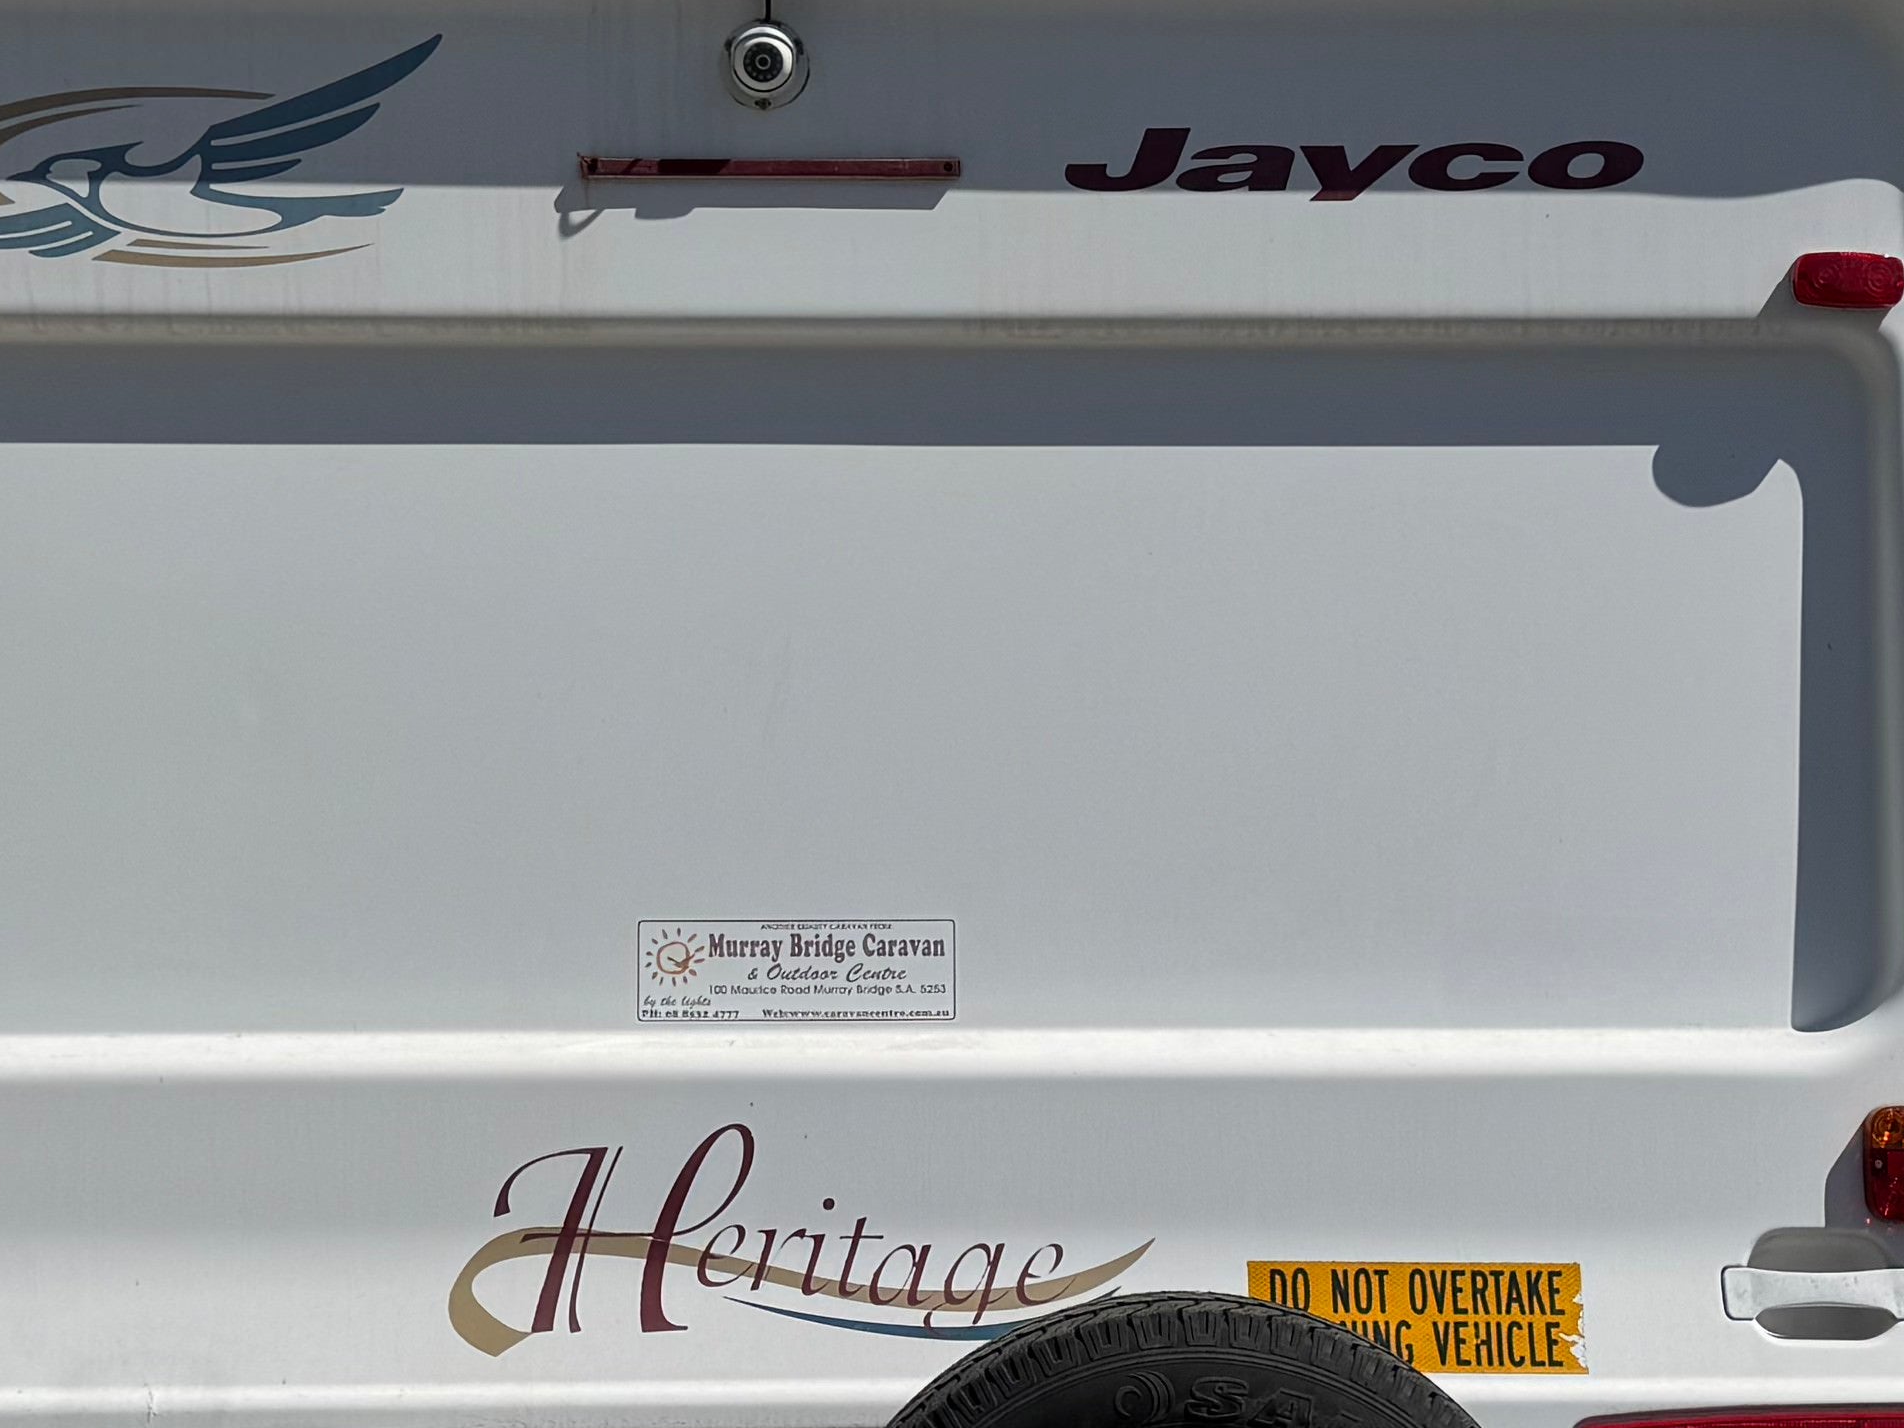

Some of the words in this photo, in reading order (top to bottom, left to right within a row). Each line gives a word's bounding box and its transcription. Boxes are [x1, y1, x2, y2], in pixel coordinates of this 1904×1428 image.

[1064, 127, 1645, 202] Jayco
[708, 932, 783, 962] Murray
[789, 932, 856, 963] Bridge
[862, 932, 945, 958] Caravan
[747, 967, 759, 981] &
[766, 962, 838, 981] Outdoor
[845, 962, 907, 983] Centre
[780, 984, 810, 995] Road
[813, 984, 853, 996] Murray
[856, 984, 893, 996] Bridge
[920, 984, 946, 994] 5253
[493, 1122, 1078, 1334] Heritage
[1269, 1267, 1311, 1312] DO
[1330, 1267, 1390, 1315] NOT
[1408, 1268, 1566, 1316] OVERTAKE
[1432, 1320, 1564, 1368] VEHICLE
